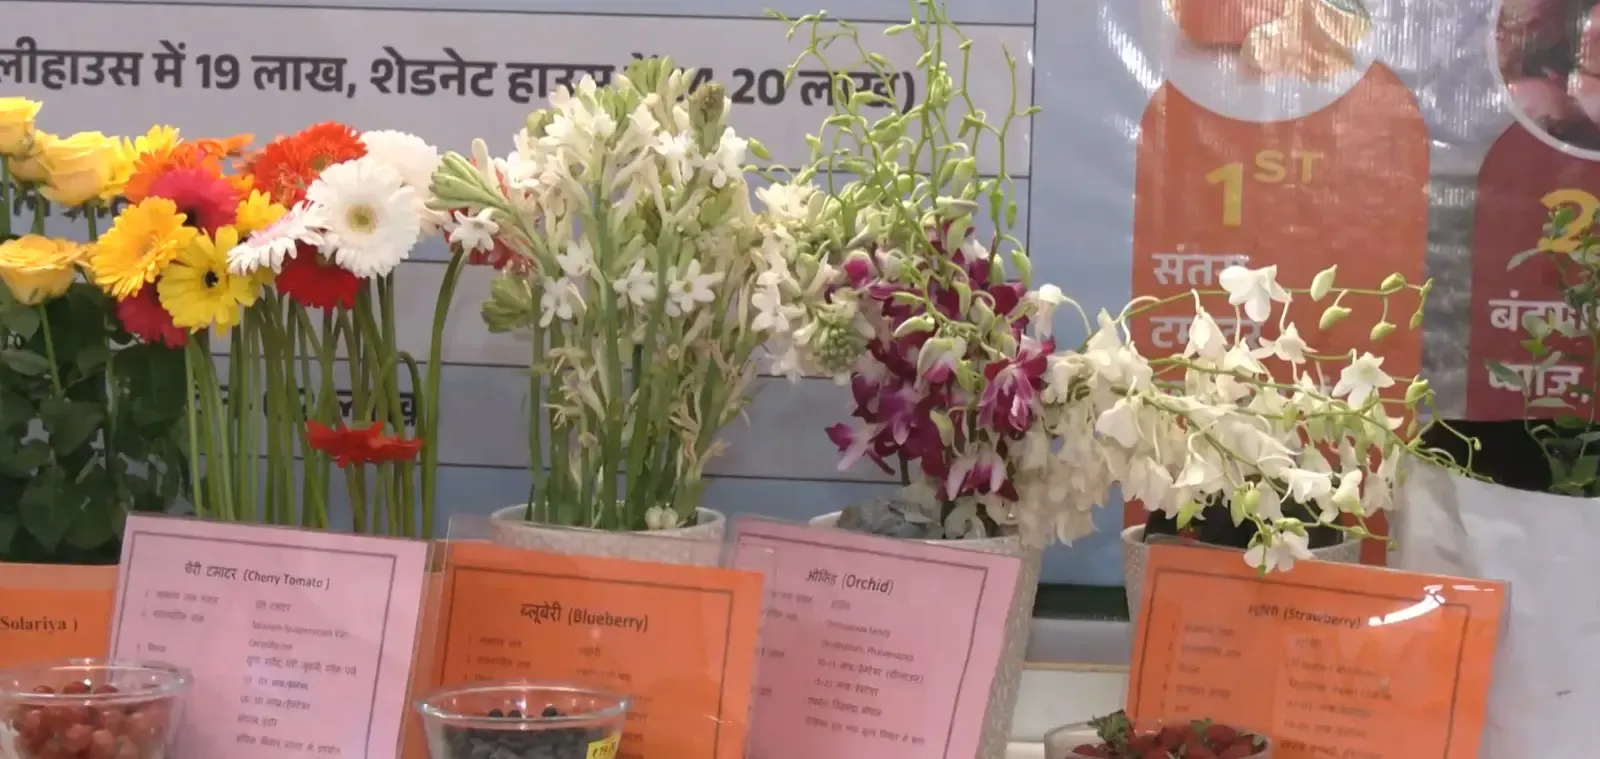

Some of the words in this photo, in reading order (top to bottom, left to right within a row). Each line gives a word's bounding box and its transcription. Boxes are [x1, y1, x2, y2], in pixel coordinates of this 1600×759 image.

[152, 40, 185, 88] में
[196, 54, 239, 89] 19
[251, 55, 356, 98] लाख,
[370, 46, 498, 98] शेडनेट
[1151, 243, 1250, 286] संत
[206, 566, 238, 580] टमाटर
[243, 568, 281, 586] (Cherry
[283, 573, 323, 588] Tomato
[841, 572, 894, 596] (Orchid)
[0, 615, 67, 637] Solariya
[567, 607, 649, 633] (Blueberry)
[1283, 607, 1361, 629] (Strawberry)
